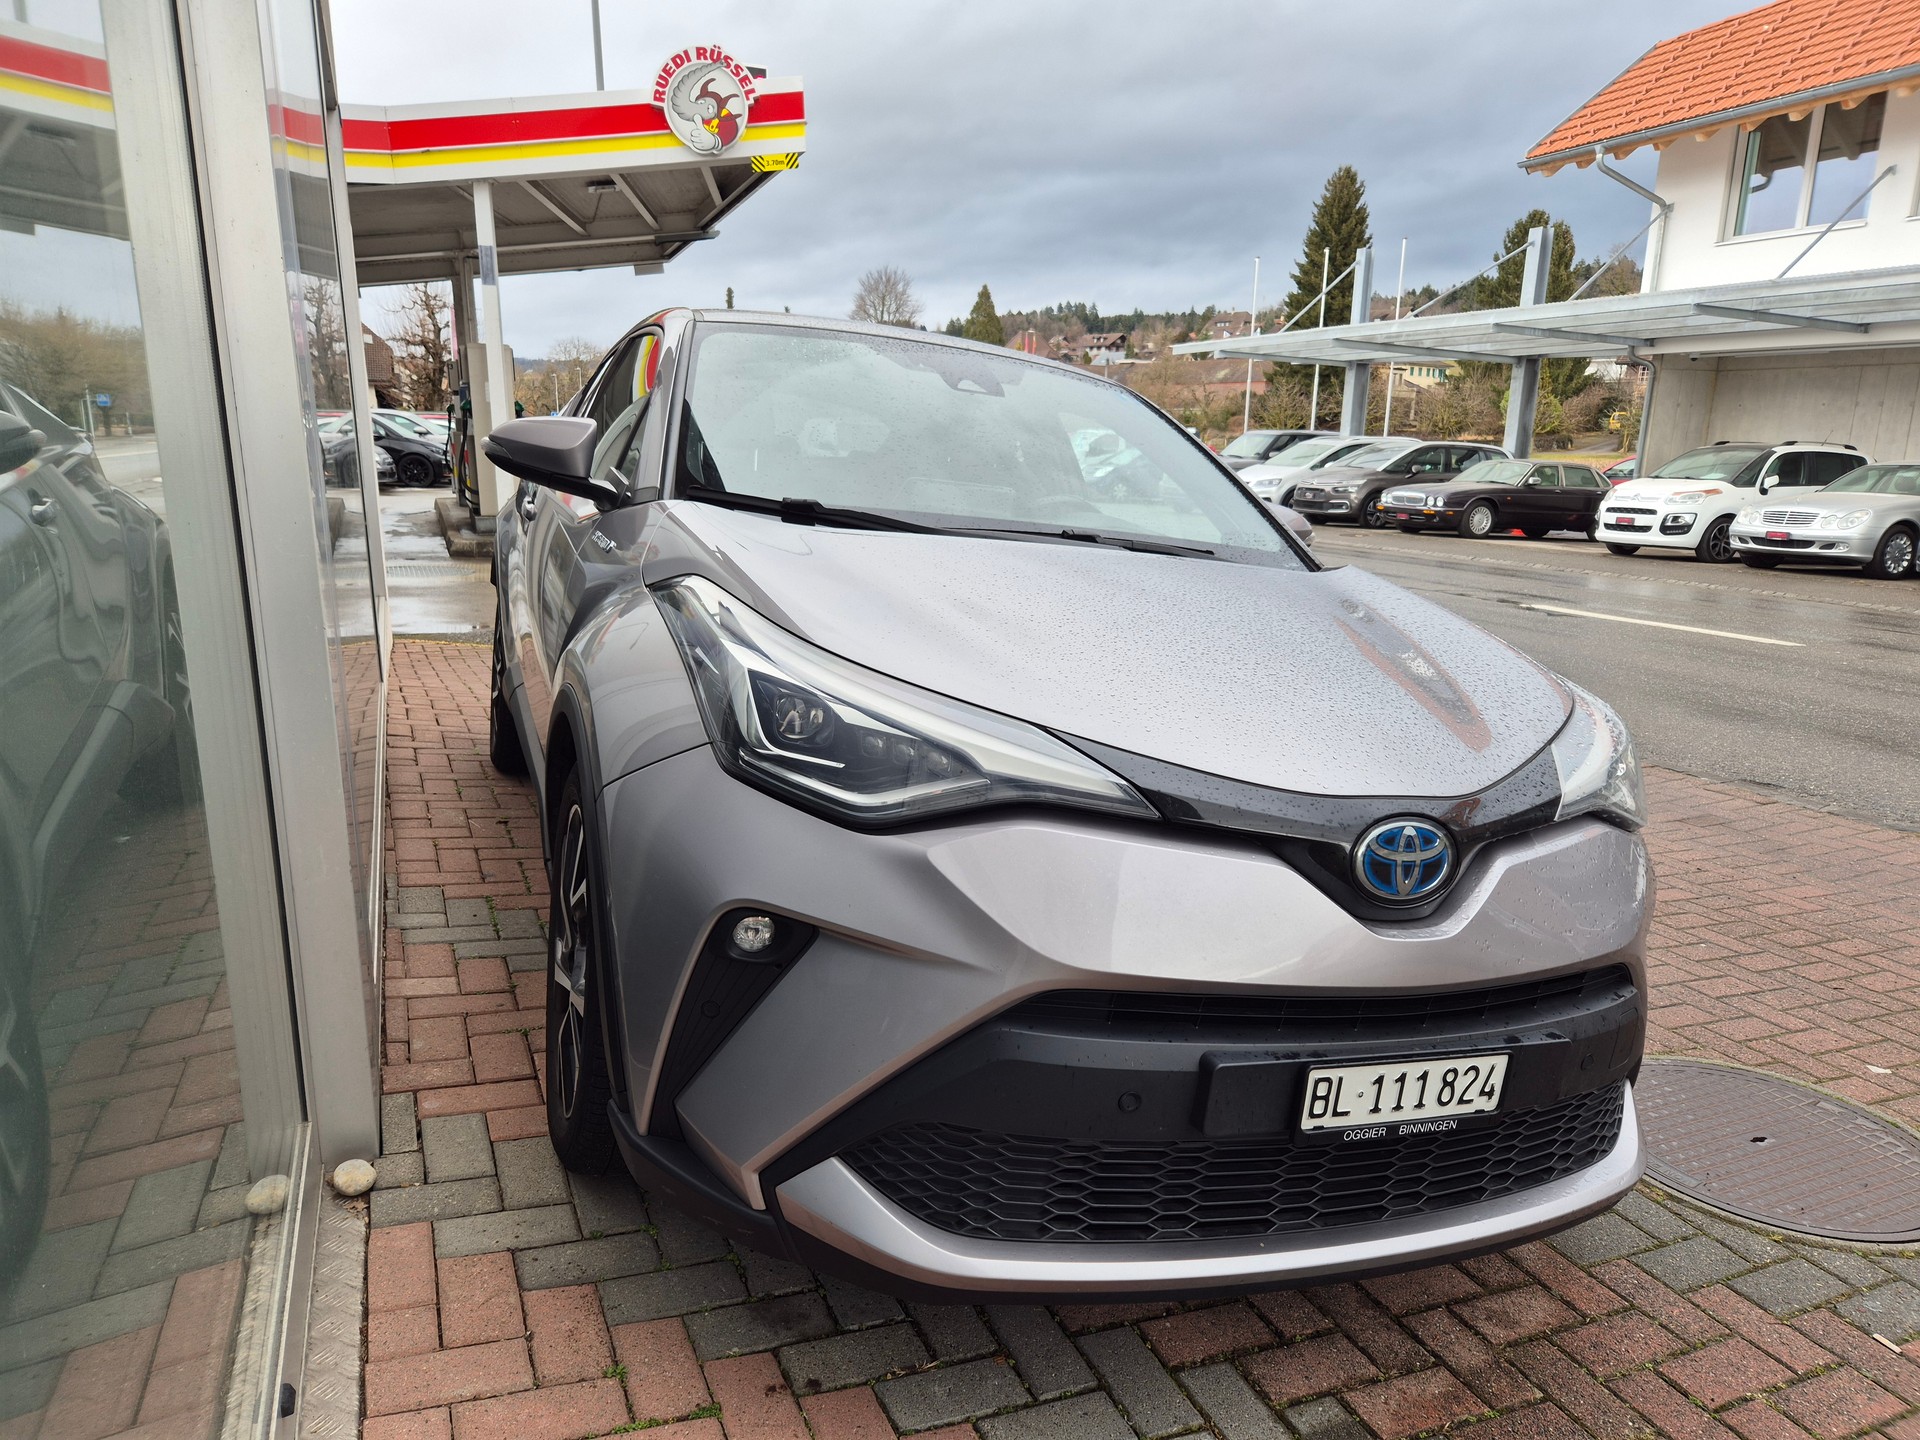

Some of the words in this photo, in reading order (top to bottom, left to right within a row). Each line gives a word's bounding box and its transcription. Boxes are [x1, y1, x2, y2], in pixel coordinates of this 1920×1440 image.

[653, 49, 692, 104] RUEDI
[695, 44, 757, 102] RÜSSEL
[1343, 1127, 1387, 1141] OGGIER
[1399, 1119, 1458, 1135] BINNINGEN
